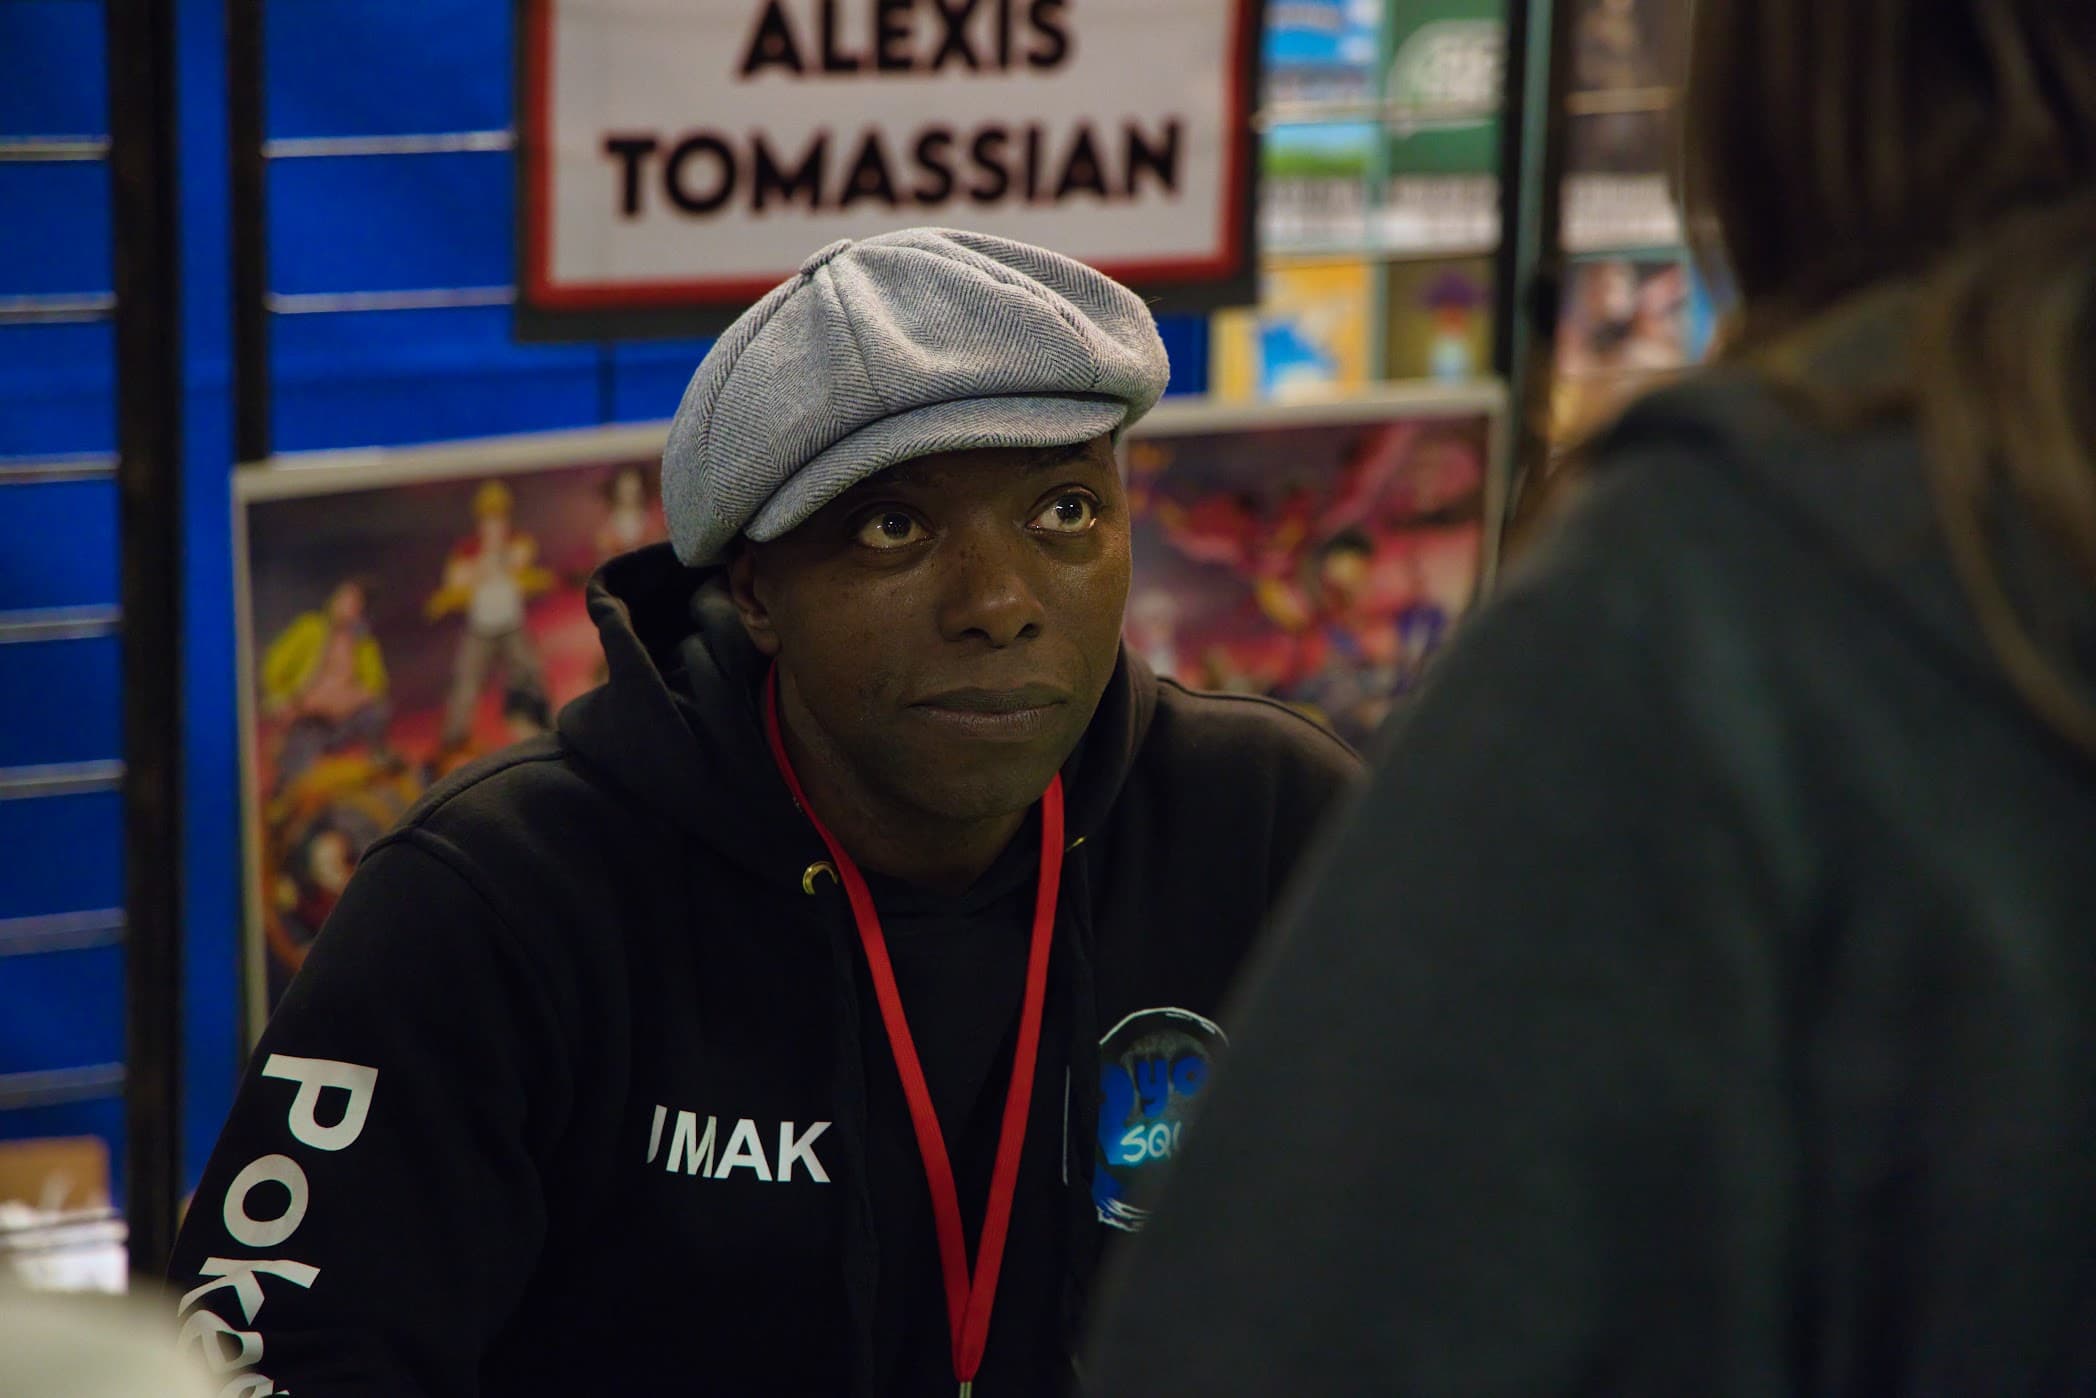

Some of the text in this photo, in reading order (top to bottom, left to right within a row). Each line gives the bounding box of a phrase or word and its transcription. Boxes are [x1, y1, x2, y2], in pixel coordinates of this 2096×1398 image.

[737, 0, 1072, 79] ALEXIS
[602, 117, 1184, 219] TOMASSIAN
[1120, 1119, 1182, 1163] SQ
